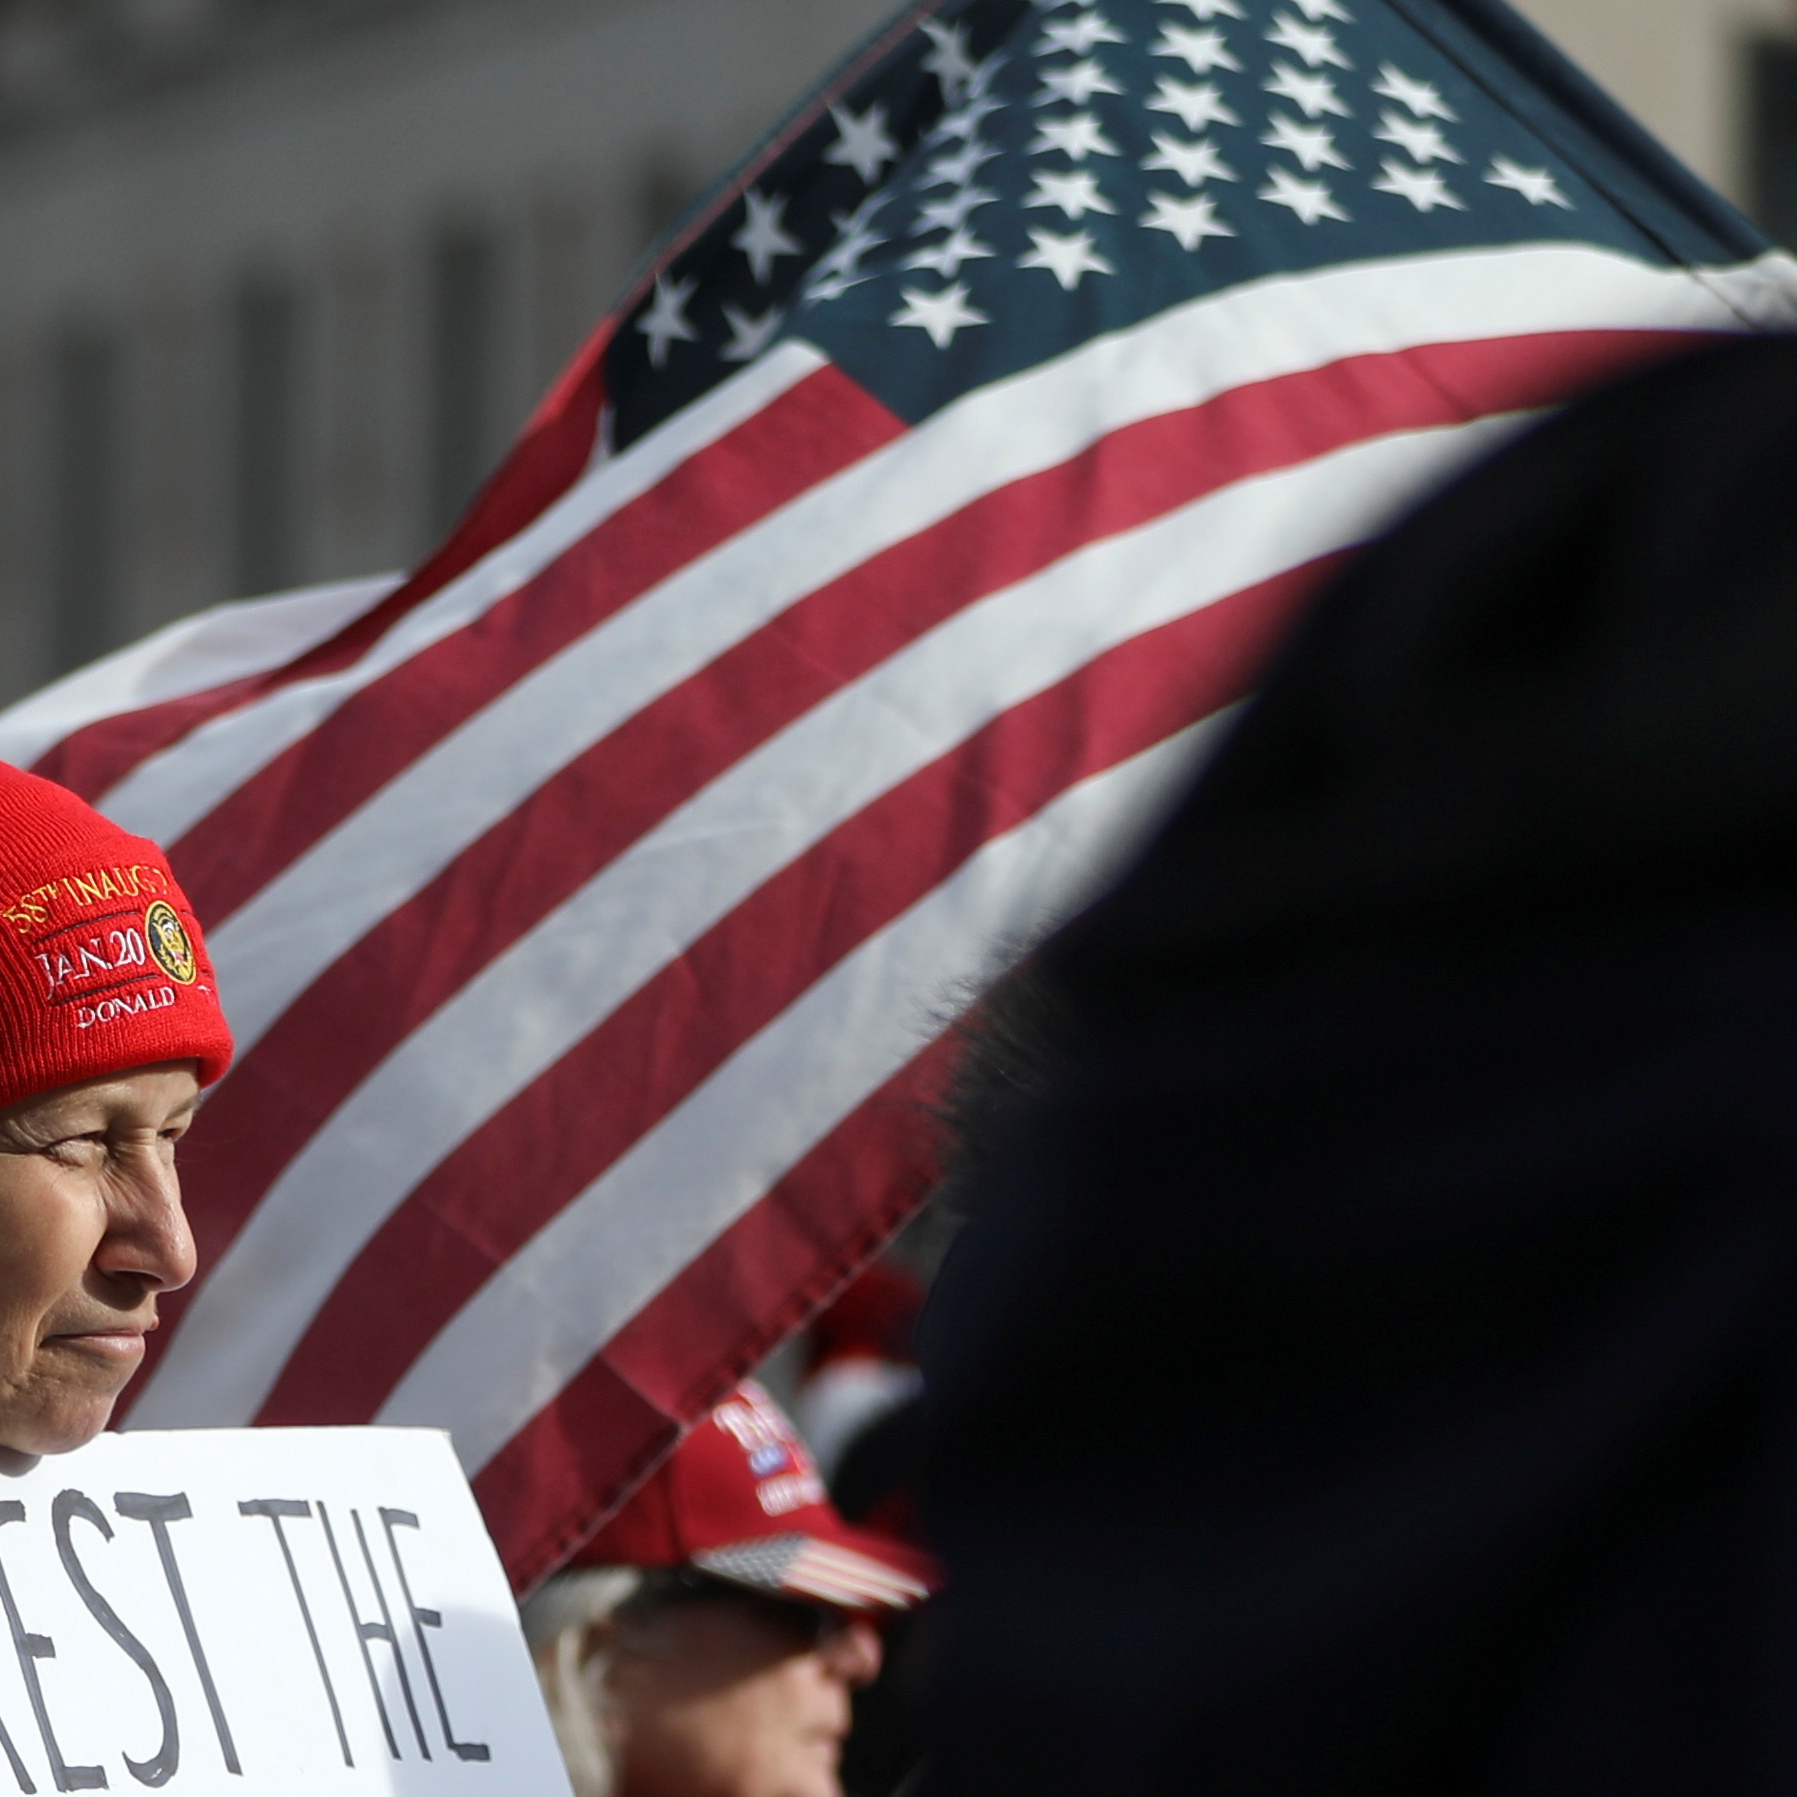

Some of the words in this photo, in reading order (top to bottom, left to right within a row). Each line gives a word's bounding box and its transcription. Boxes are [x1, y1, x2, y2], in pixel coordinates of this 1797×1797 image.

[0, 881, 60, 934] 58TH
[77, 986, 175, 1028] DONALD
[239, 1499, 491, 1768] THE
